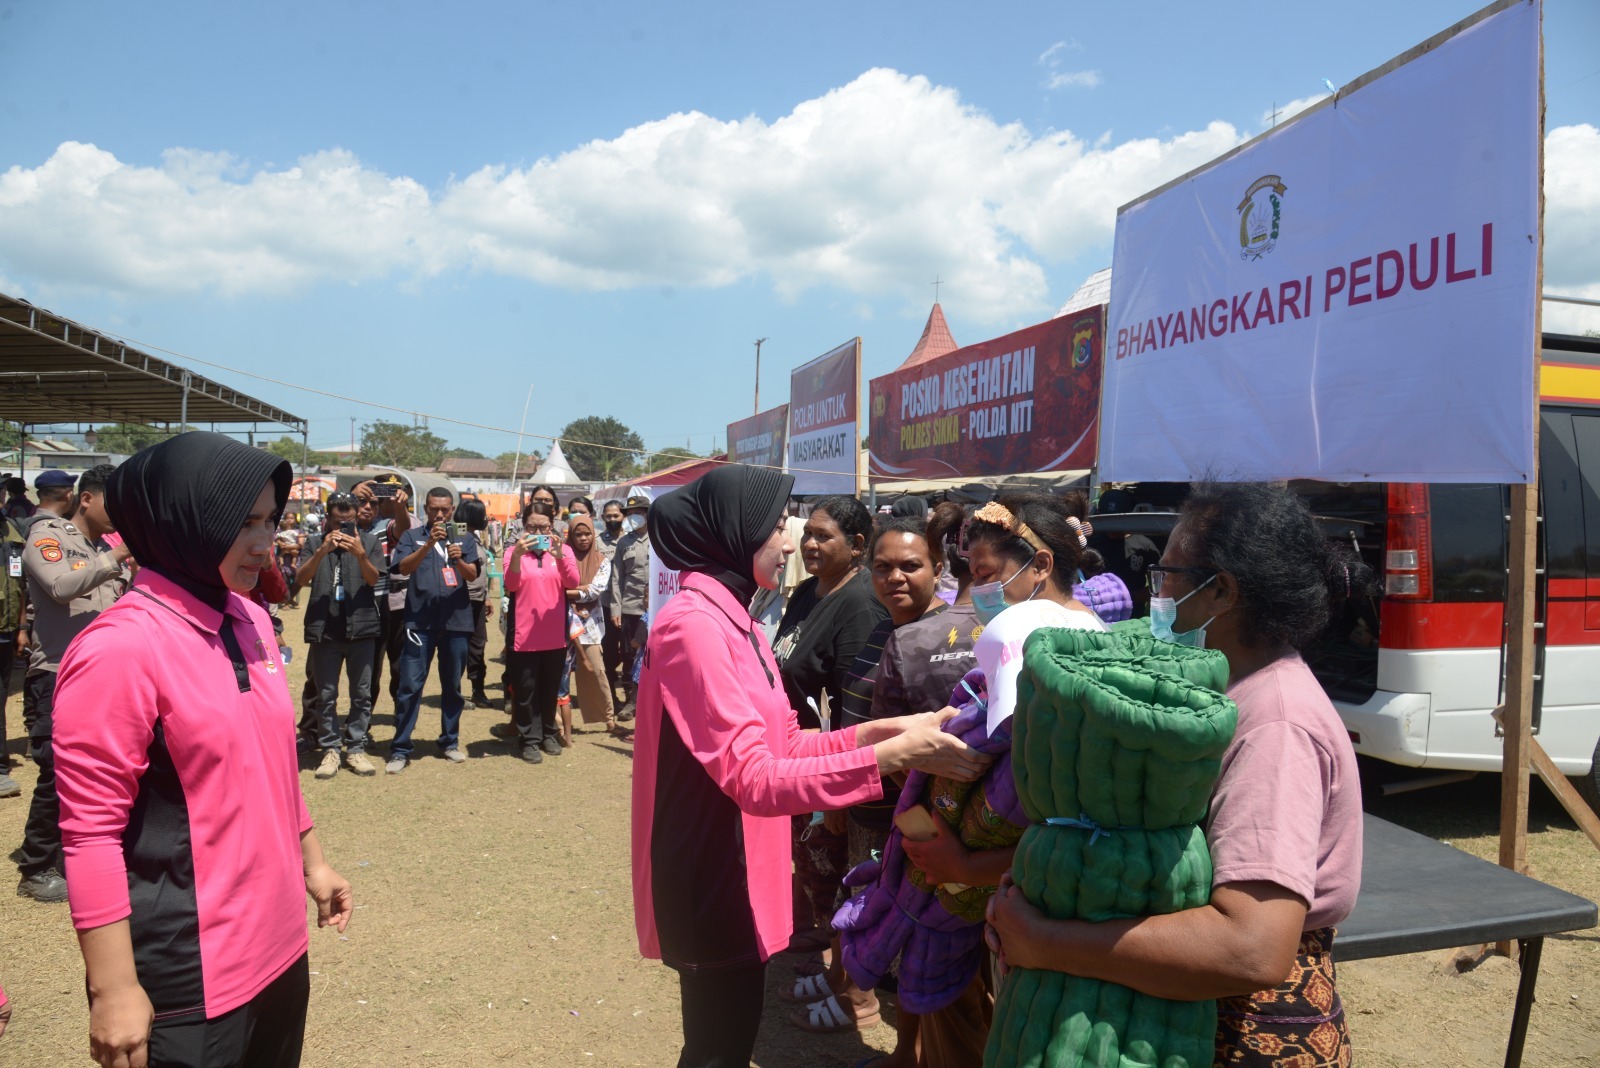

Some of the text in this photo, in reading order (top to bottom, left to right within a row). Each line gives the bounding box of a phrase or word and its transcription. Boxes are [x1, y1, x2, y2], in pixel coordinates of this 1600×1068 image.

[1115, 222, 1493, 360] BHAYANGKARI PEDULI
[901, 346, 1036, 420] POSKO KESEHATAN
[794, 393, 847, 430] POLRI UNTUK
[900, 421, 932, 451] POLRES
[933, 415, 959, 446] SIKKA
[968, 404, 1007, 440] POLDA
[1010, 399, 1034, 434] NTT
[793, 432, 847, 462] MASYARAKAT
